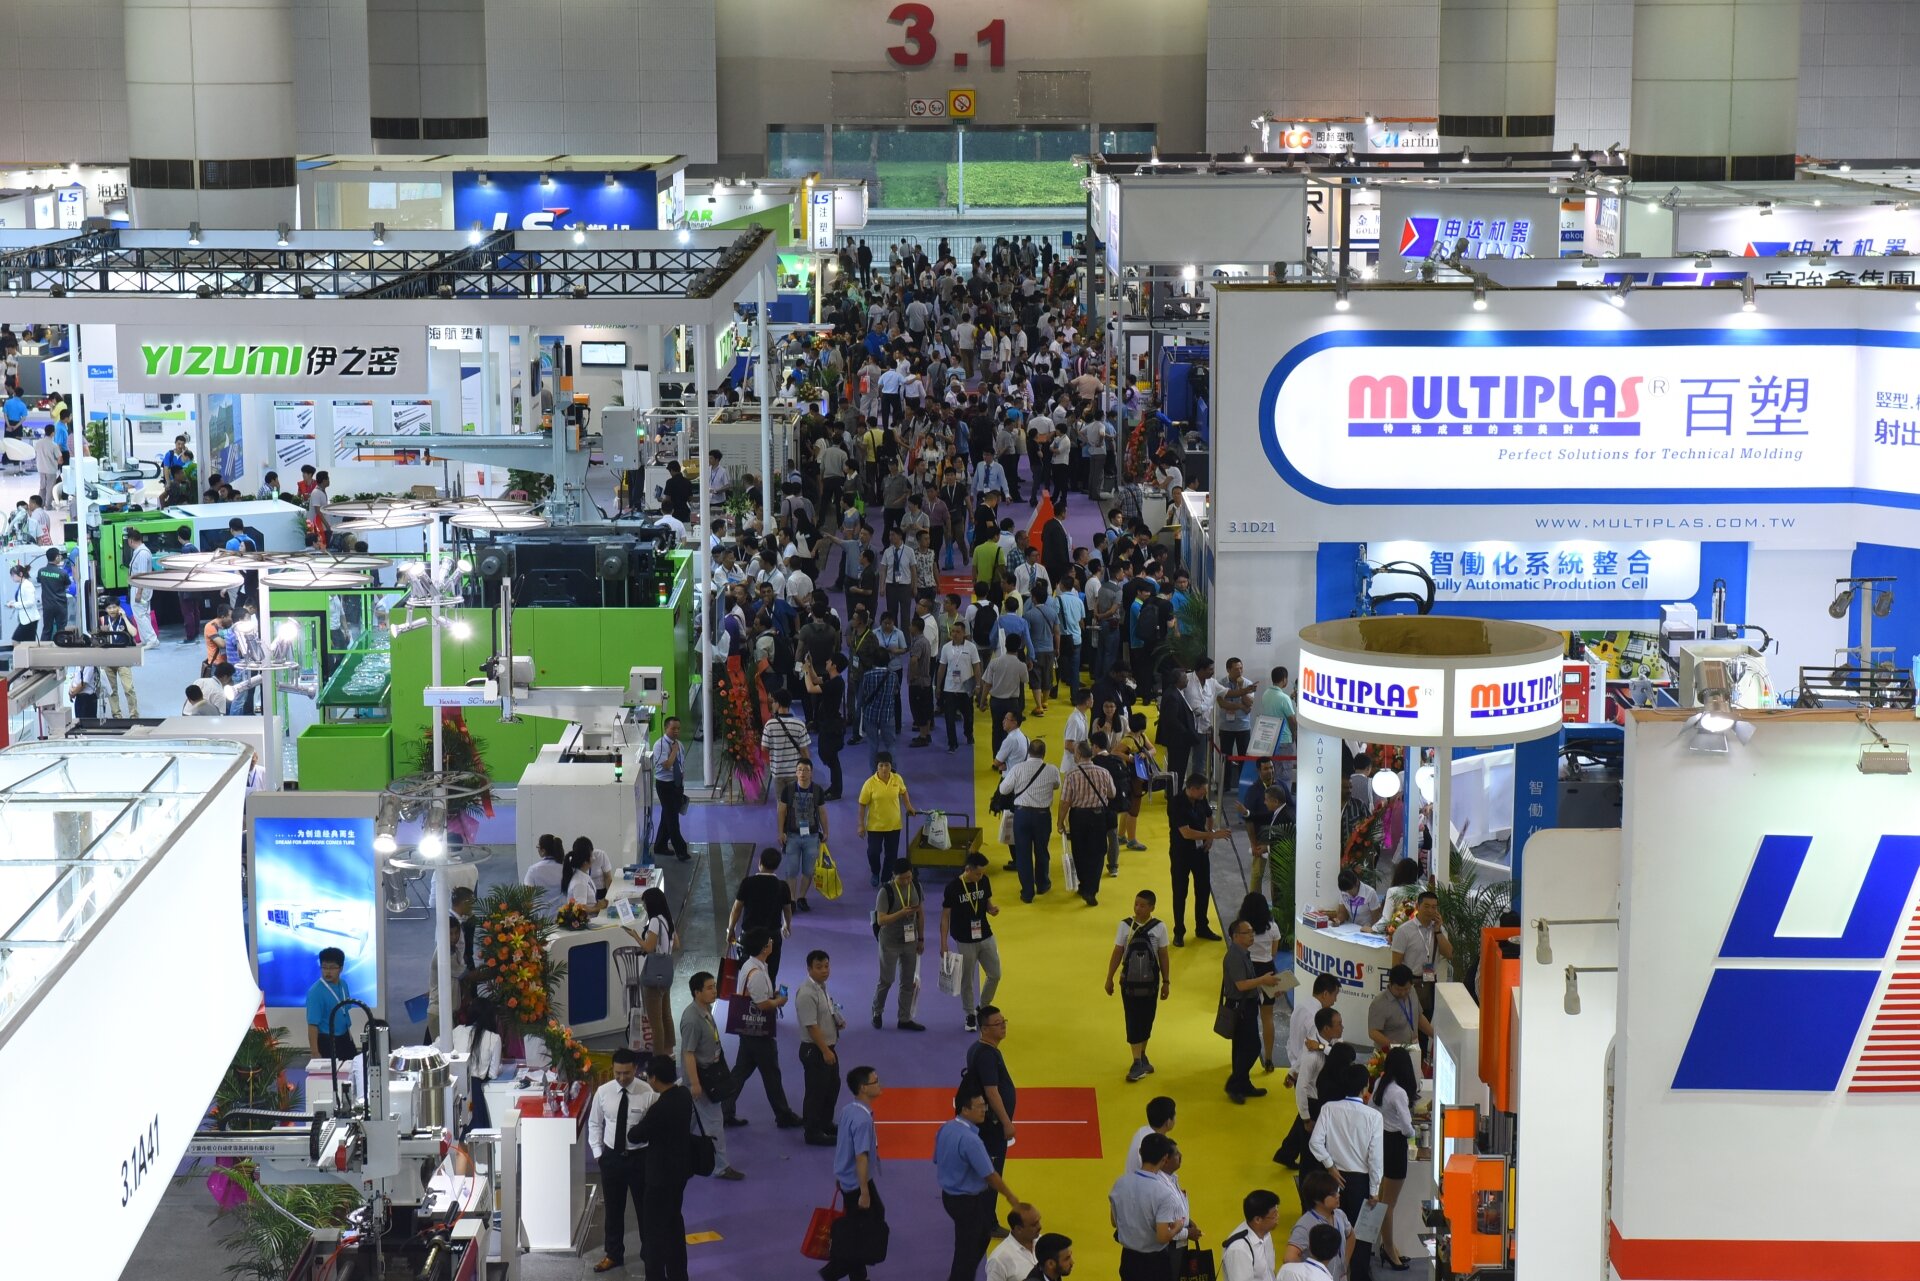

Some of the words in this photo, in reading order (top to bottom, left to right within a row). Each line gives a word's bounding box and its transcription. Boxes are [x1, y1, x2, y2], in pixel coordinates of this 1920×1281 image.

[887, 3, 1005, 67] 3.1
[58, 192, 78, 203] LS
[814, 194, 829, 205] LS
[819, 206, 828, 247] 注塑机
[1444, 219, 1529, 242] 申达机器
[141, 345, 303, 376] YIZUMI
[306, 346, 400, 376] 伊之密
[1348, 375, 1644, 420] MULTIPLAS
[1680, 374, 1810, 438] 百塑
[1497, 449, 1551, 461] Perfect
[1557, 448, 1629, 461] Solutions
[1634, 447, 1656, 460] for
[1662, 448, 1734, 460] Technical
[1739, 448, 1803, 463] Molding
[1229, 521, 1276, 533] 3.1D21
[1535, 517, 1796, 528] WWW.MULTIPLAS.COM.TW
[1466, 578, 1540, 590] Automatic
[1544, 577, 1616, 590] Prodution
[1621, 576, 1649, 590] Cell
[1303, 667, 1420, 709] MULTIPLAS
[1296, 939, 1364, 981] MULTIPLAS
[121, 1112, 159, 1208] 3.1A41
